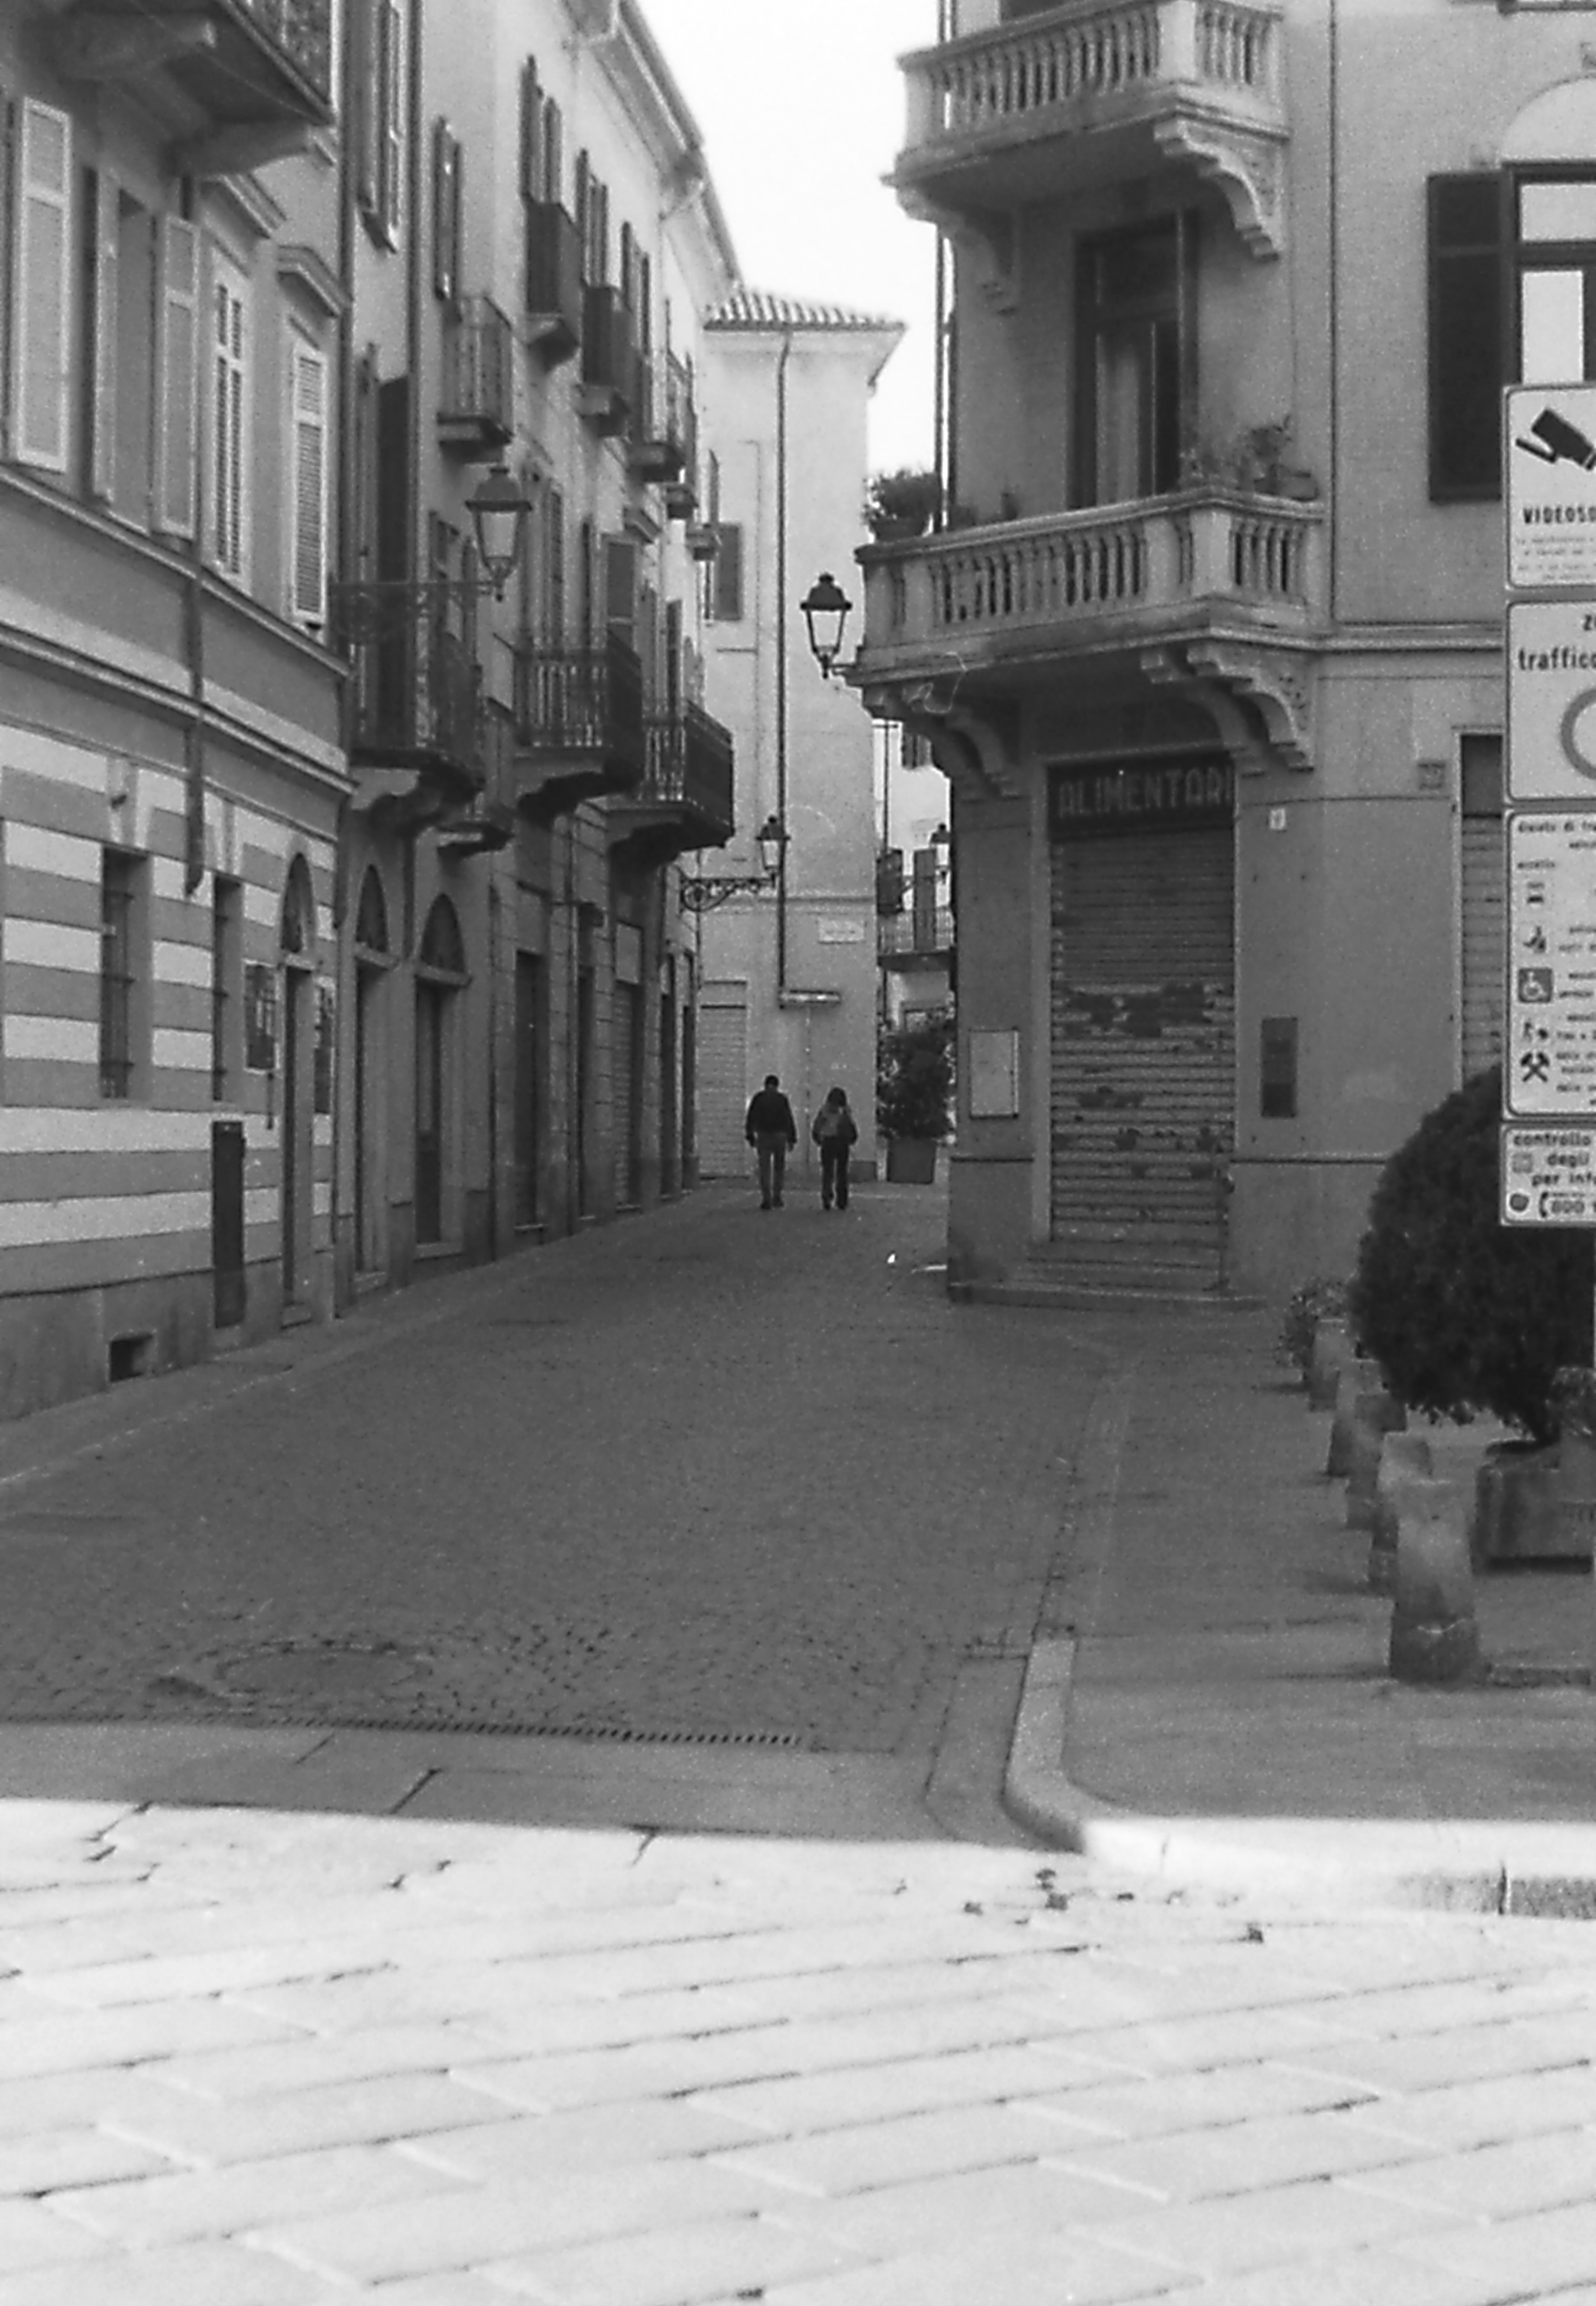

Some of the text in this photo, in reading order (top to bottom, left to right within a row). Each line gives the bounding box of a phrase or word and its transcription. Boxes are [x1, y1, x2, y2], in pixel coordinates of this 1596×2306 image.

[1059, 766, 1233, 819] ALIMENTARI
[1513, 1131, 1591, 1146] controllo
[1532, 1174, 1559, 1187] per
